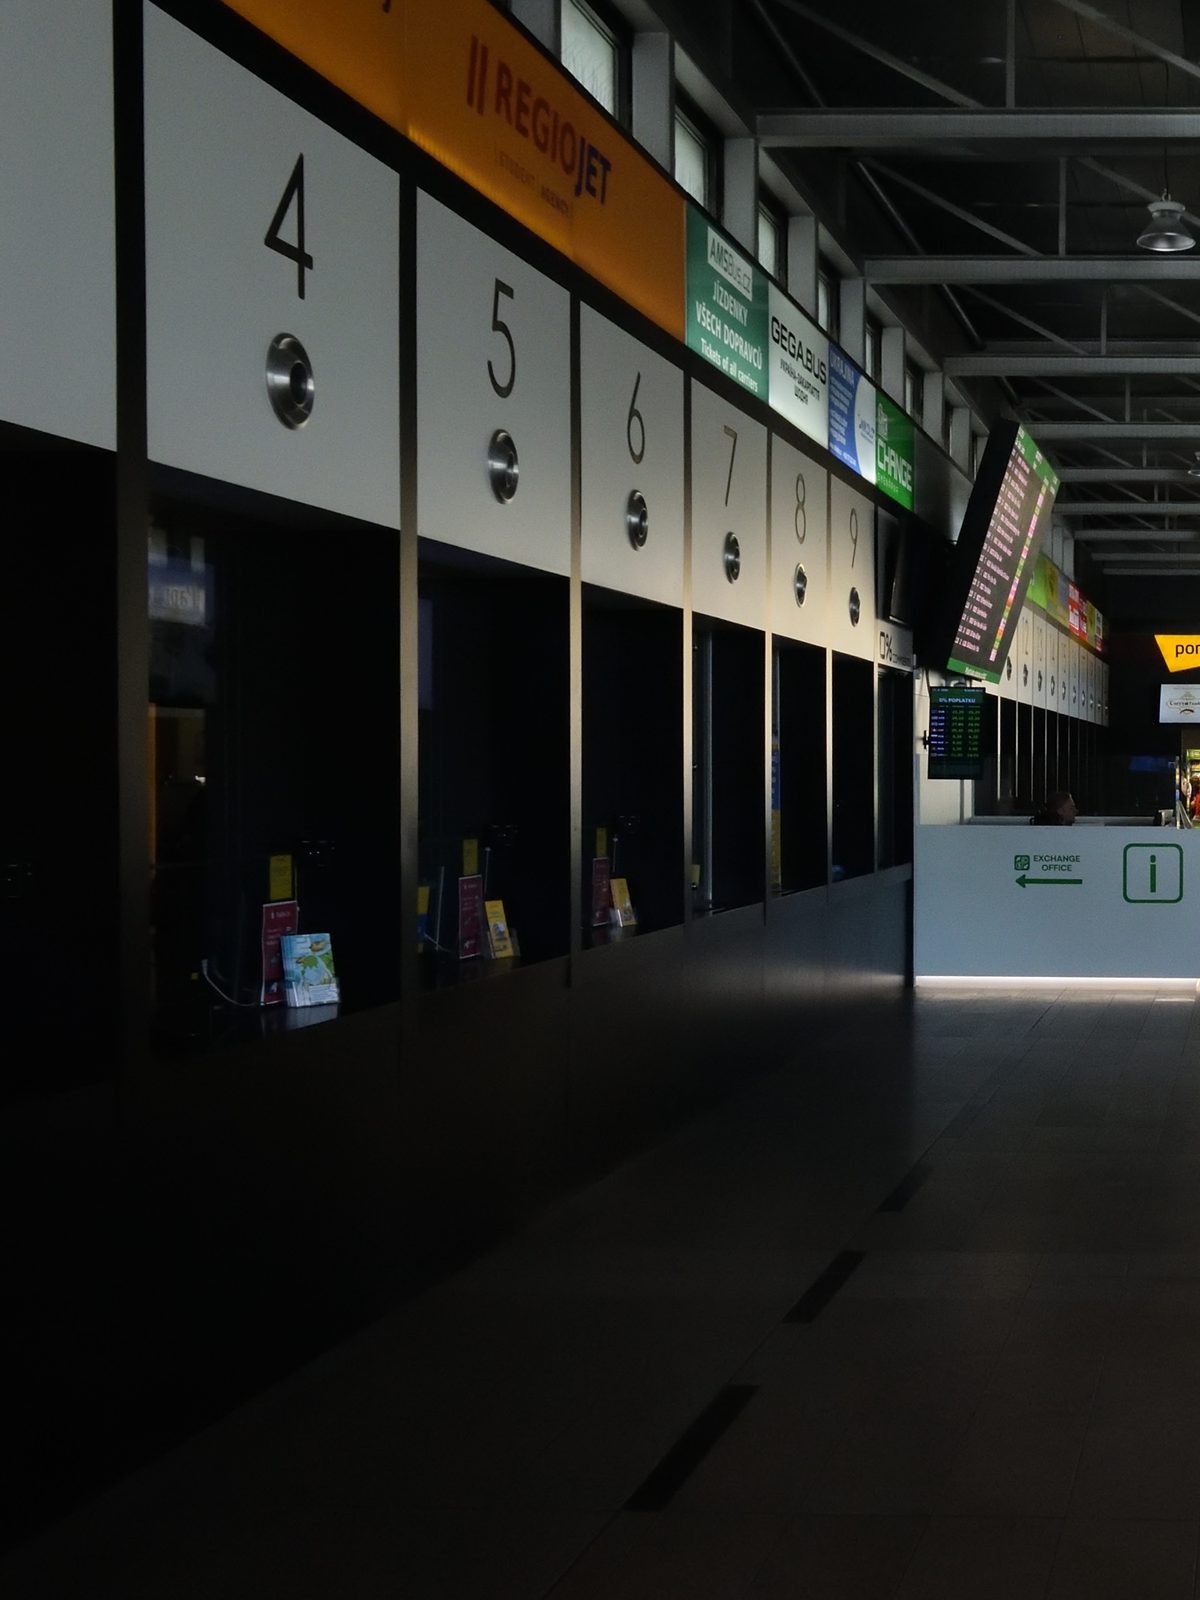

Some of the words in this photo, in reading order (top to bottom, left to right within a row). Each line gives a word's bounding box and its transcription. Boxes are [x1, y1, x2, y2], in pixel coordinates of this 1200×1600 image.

[494, 60, 612, 205] REGIOJET
[264, 153, 314, 300] 4
[487, 277, 516, 398] 5
[696, 300, 722, 341] VŠECH
[771, 315, 827, 385] GEGABUS
[627, 371, 645, 464] 6
[723, 424, 738, 507] 7
[795, 473, 806, 544] 8
[850, 507, 858, 568] 9
[1033, 855, 1081, 863] EXCHANGE
[1041, 864, 1073, 872] OFFICE
